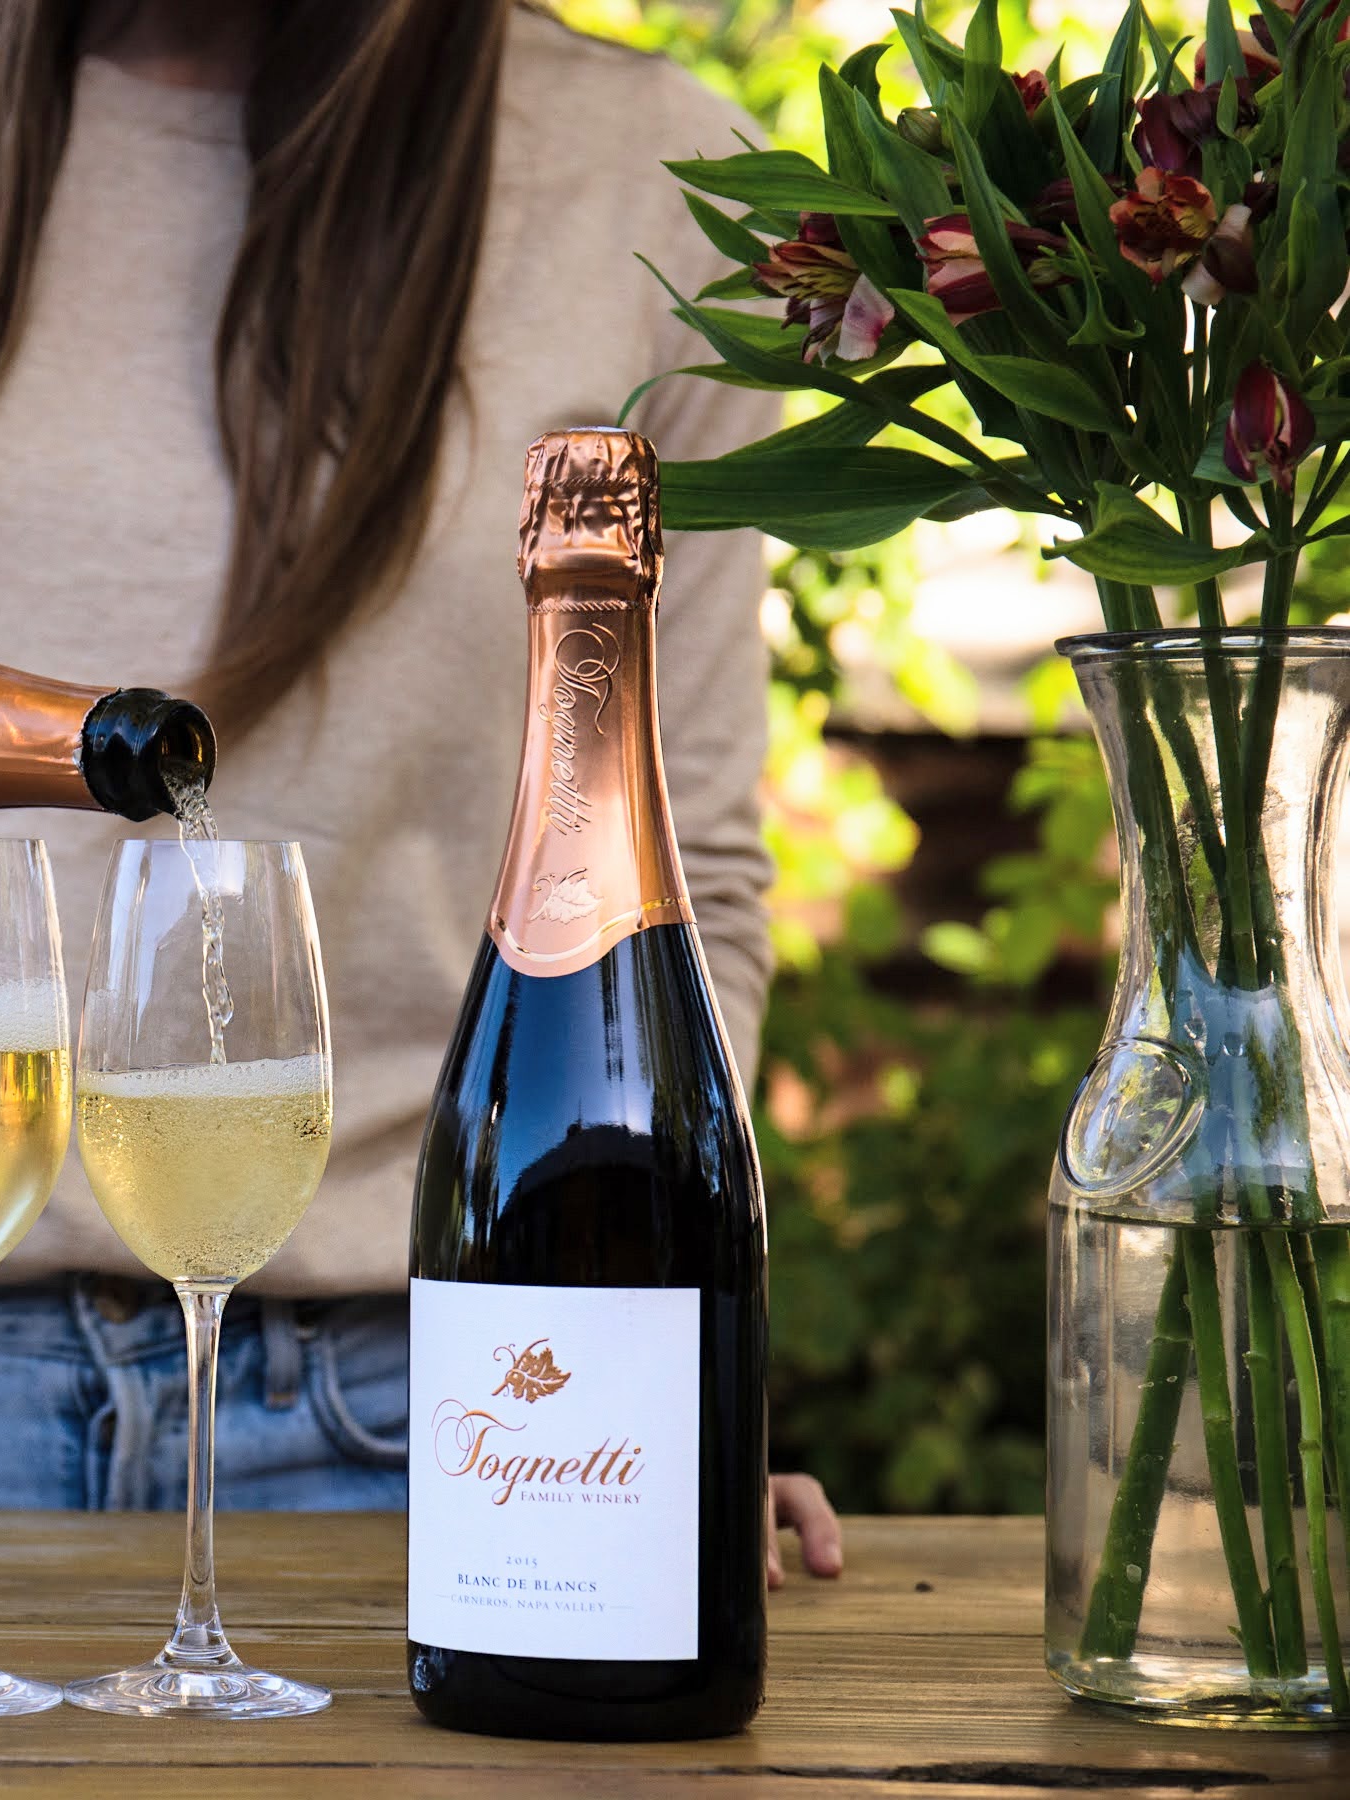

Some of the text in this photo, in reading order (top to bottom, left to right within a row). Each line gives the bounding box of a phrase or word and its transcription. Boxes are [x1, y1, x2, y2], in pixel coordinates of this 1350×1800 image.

[537, 622, 622, 837] Tognetti
[430, 1398, 646, 1506] Tognetti
[521, 1490, 642, 1505] FAMILY WINERY
[505, 1555, 539, 1569] 2015
[457, 1573, 598, 1593] BLANC DE BLANCS
[517, 1599, 549, 1611] NAPA
[554, 1601, 606, 1613] VALLEY
